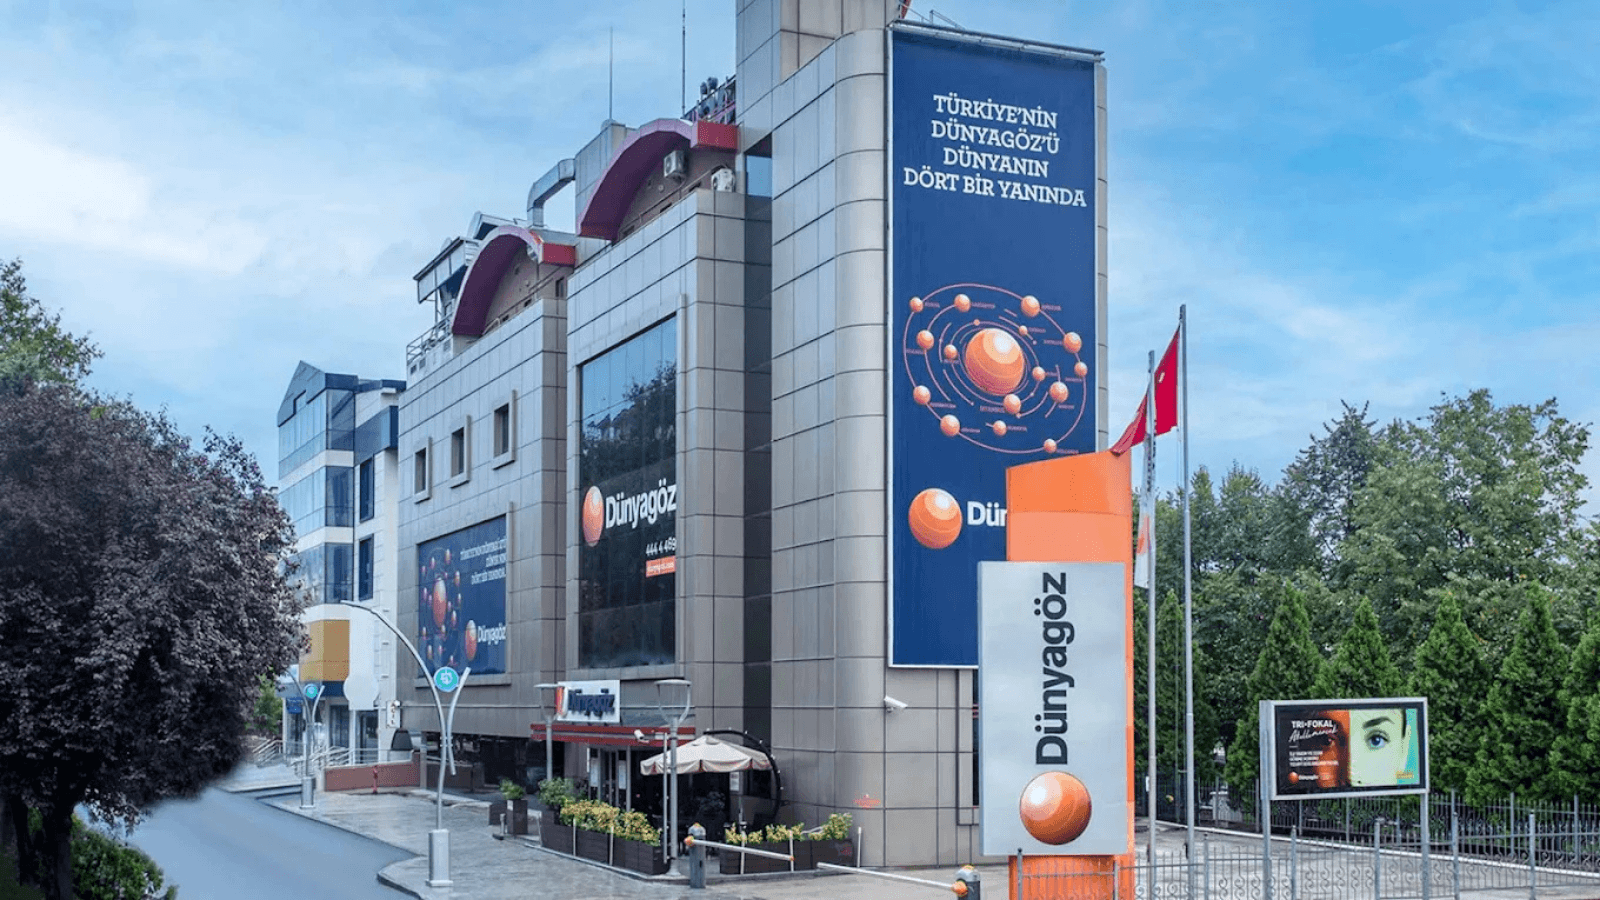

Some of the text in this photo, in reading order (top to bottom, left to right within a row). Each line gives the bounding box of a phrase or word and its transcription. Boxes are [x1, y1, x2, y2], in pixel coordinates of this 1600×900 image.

[943, 145, 1049, 178] DÜNYANIN
[903, 165, 1087, 207] DÖRT BİR YANINDA
[605, 478, 677, 529] Dünyagöz
[1034, 572, 1075, 765] Dünyagöz
